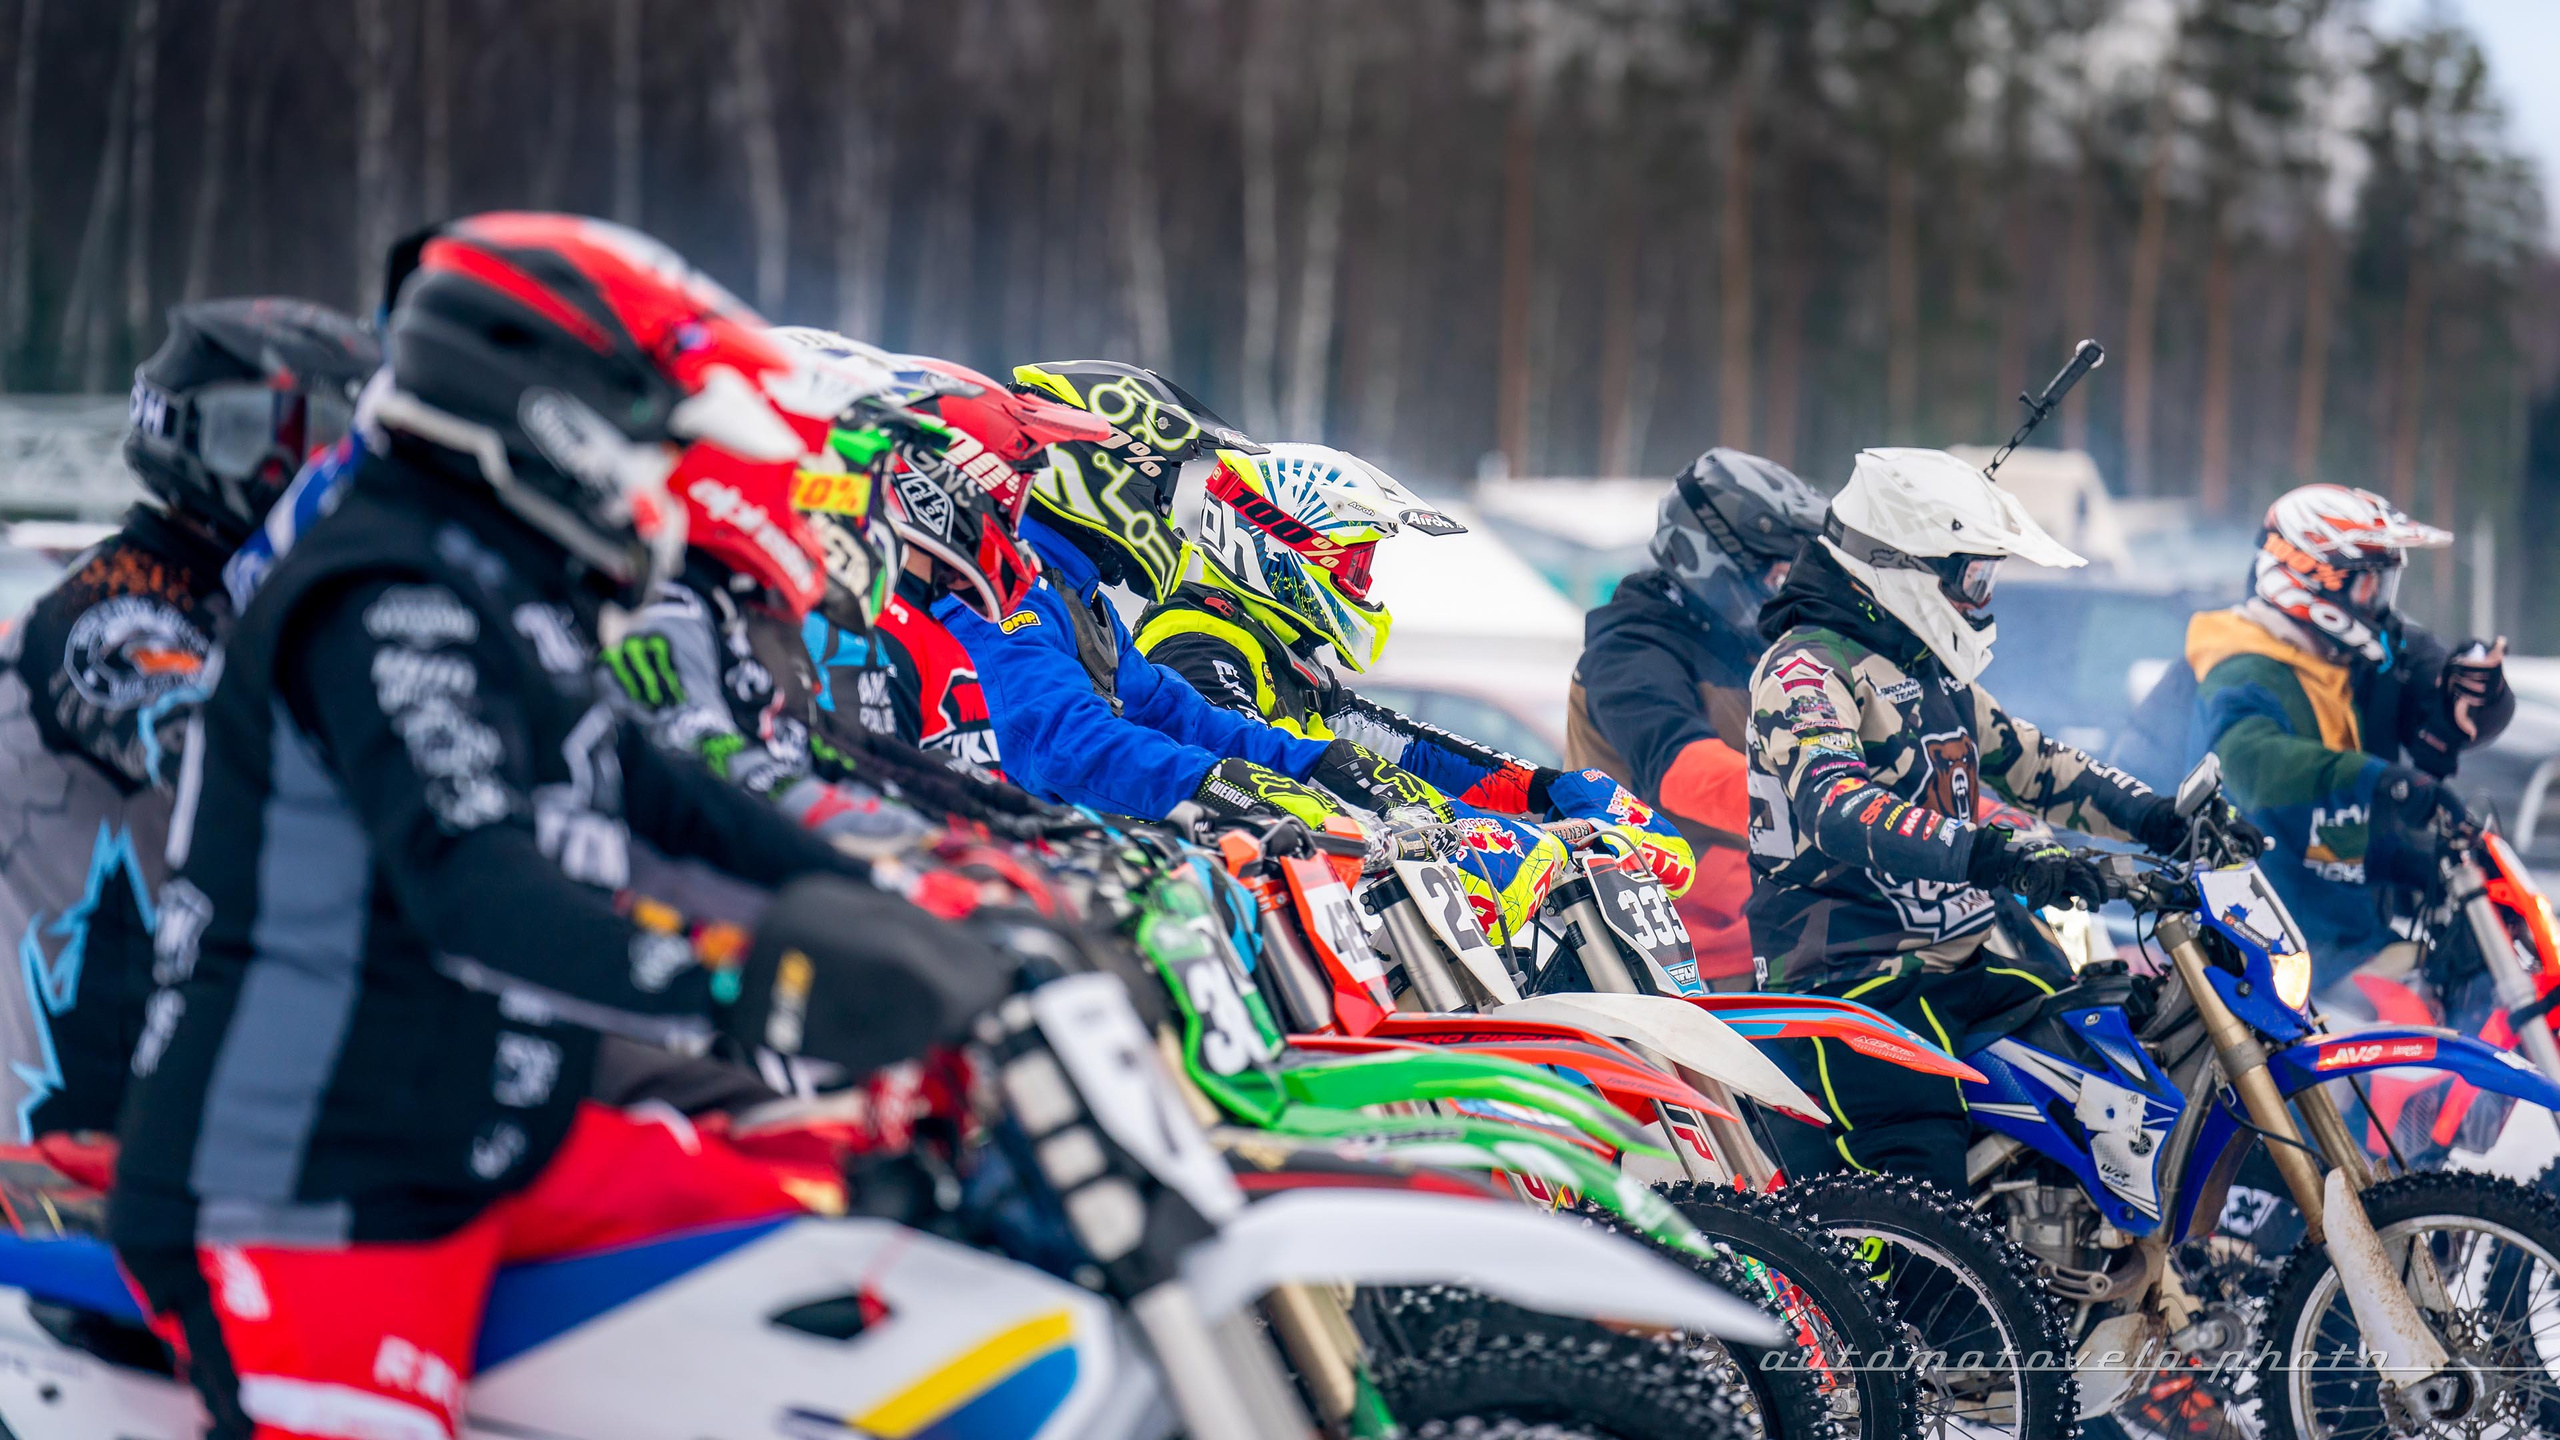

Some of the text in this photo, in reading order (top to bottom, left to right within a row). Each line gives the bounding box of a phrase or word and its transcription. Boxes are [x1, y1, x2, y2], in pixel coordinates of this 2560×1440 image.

[1229, 486, 1348, 569] 100%
[2264, 533, 2348, 591] 100%
[2332, 1044, 2384, 1064] AVS
